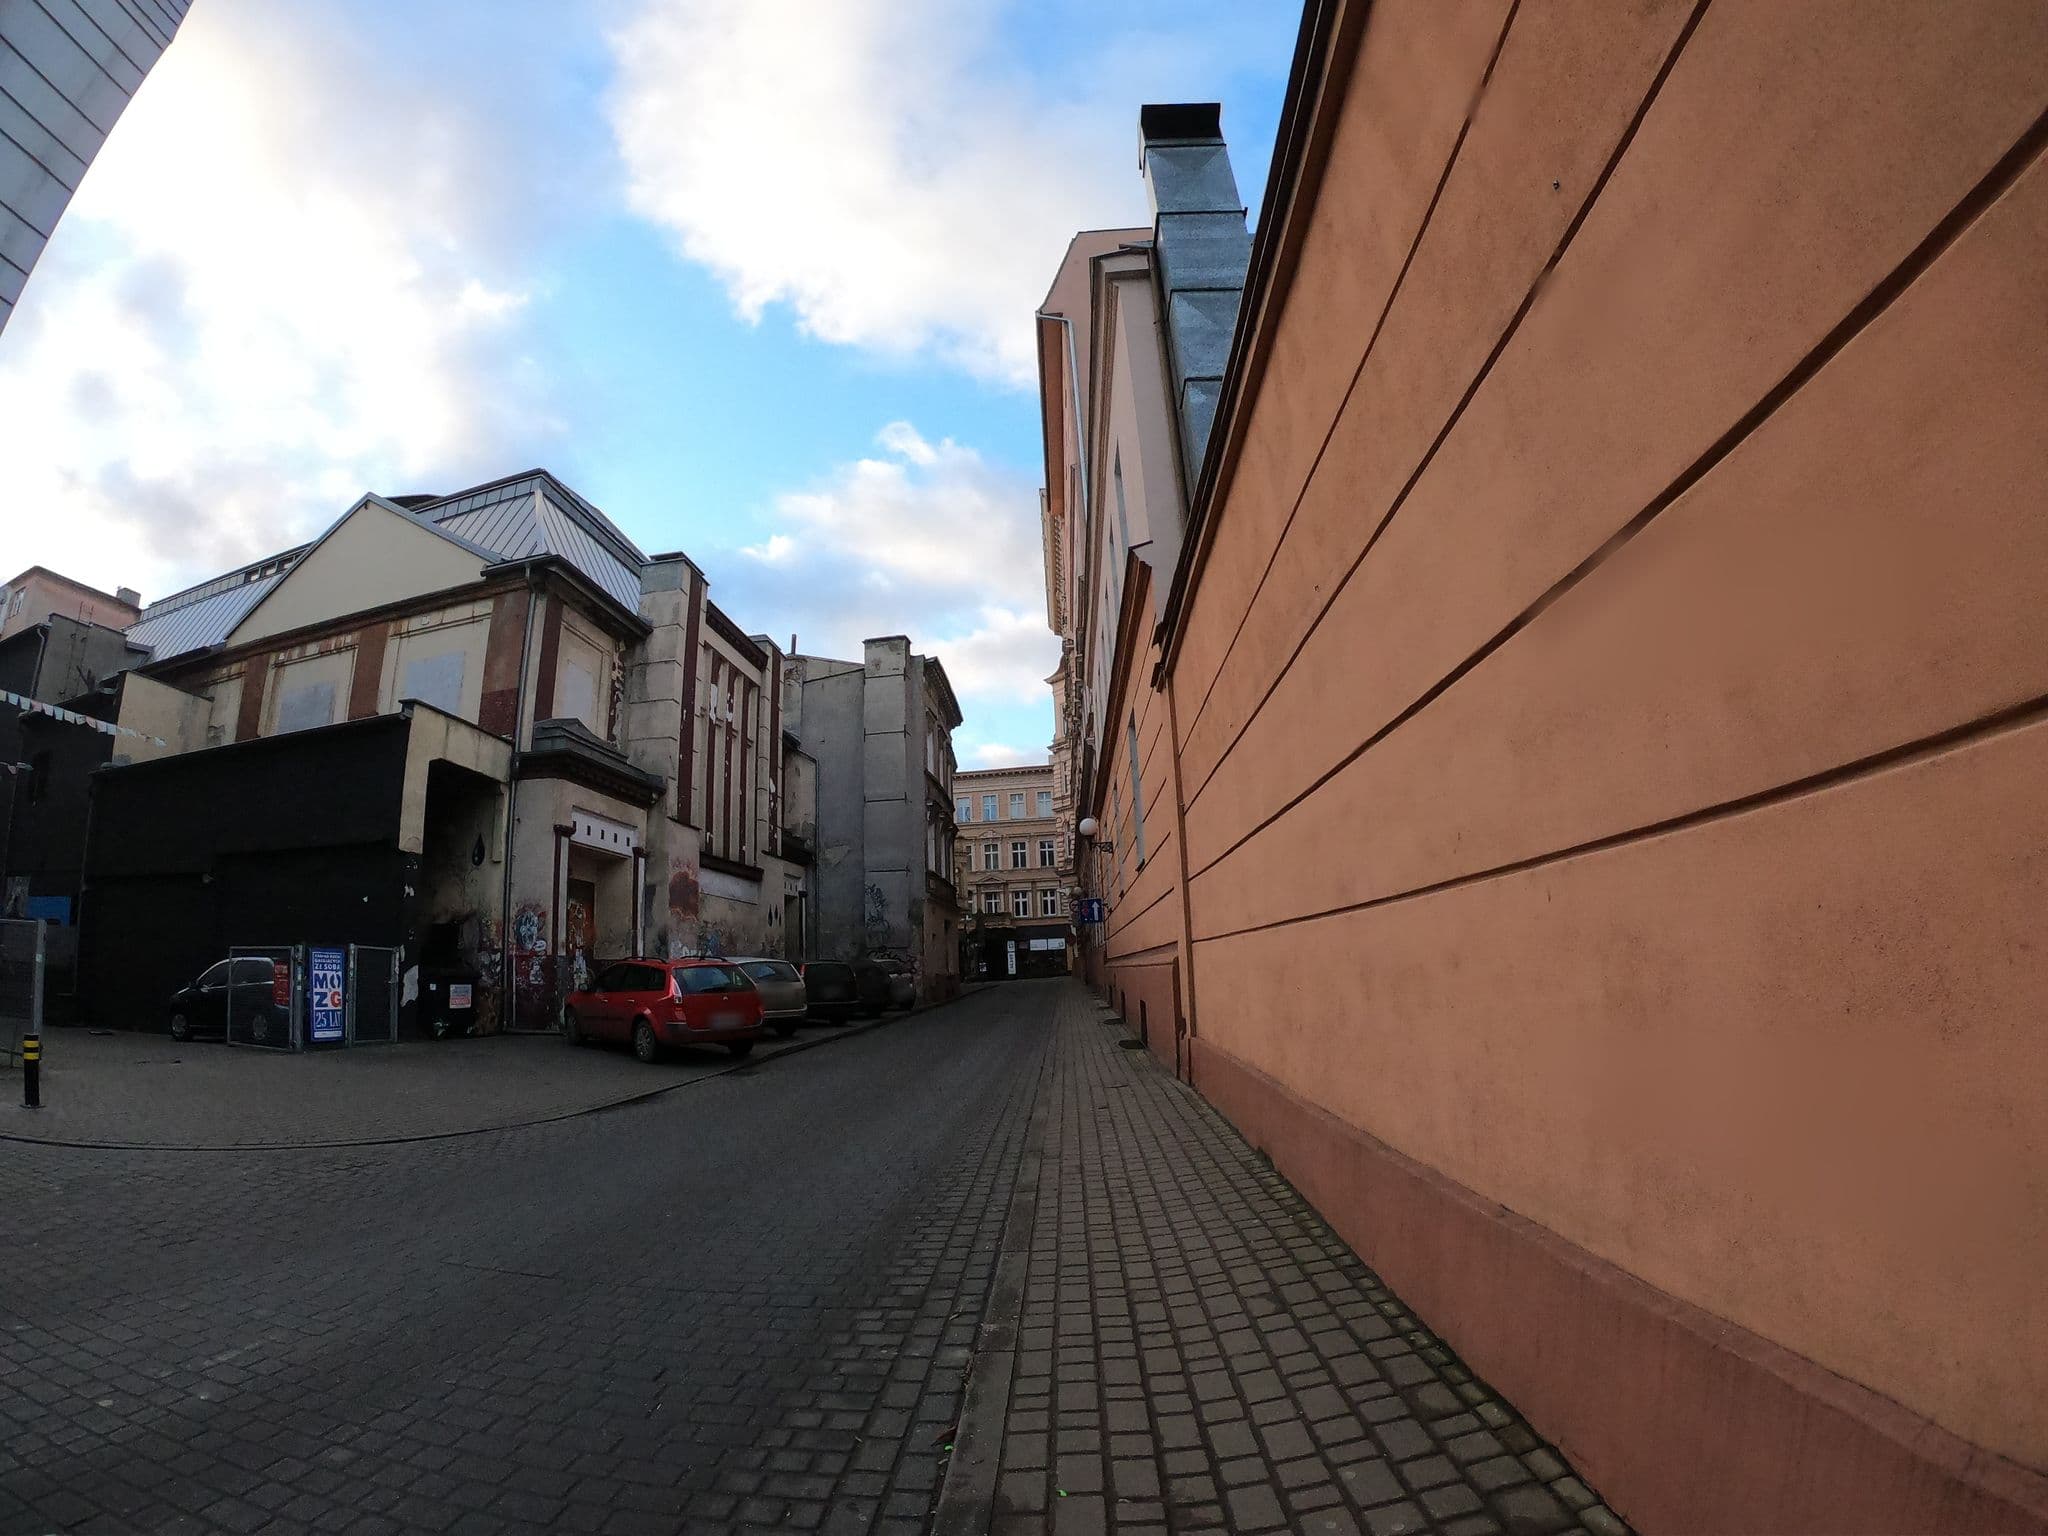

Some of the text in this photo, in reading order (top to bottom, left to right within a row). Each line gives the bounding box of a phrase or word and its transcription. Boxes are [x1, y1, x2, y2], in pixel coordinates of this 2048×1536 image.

[314, 991, 341, 1007] ZG
[316, 1011, 341, 1027] 25 LAT
